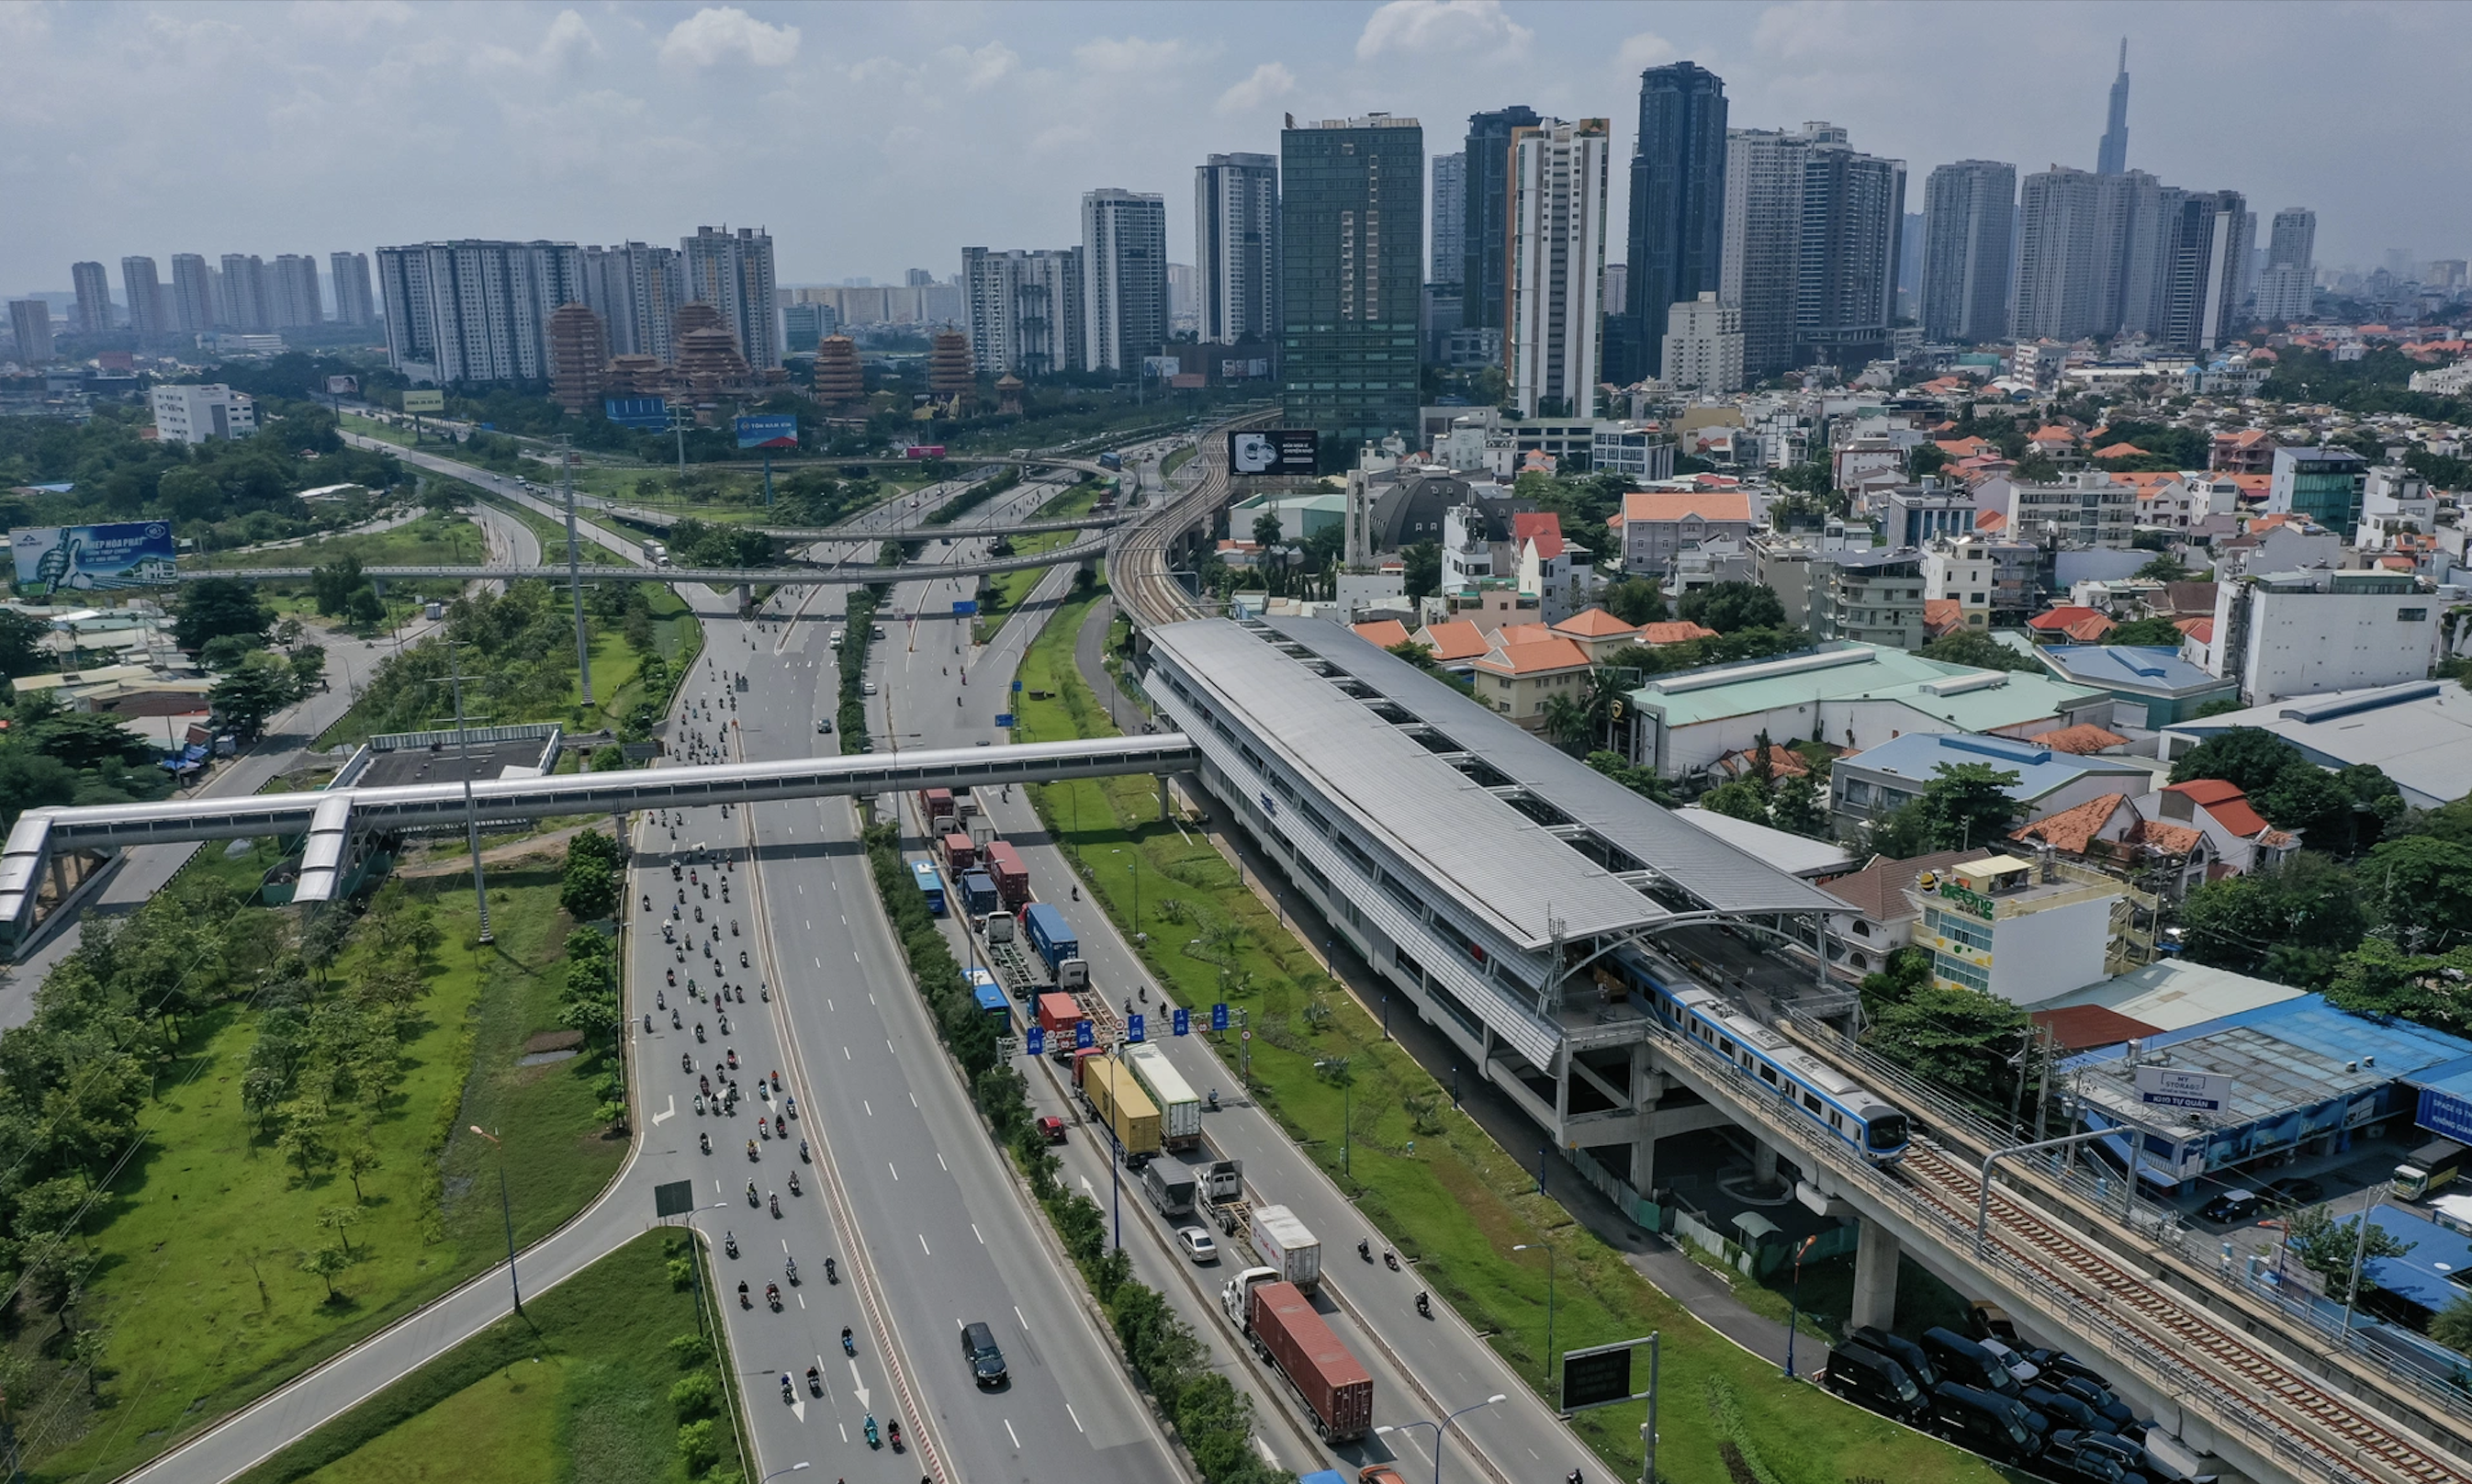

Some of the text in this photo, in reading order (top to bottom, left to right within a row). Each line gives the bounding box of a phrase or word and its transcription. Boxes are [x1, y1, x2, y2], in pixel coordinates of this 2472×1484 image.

[2166, 1082, 2201, 1091] STORAGE
[2433, 1098, 2455, 1112] SPACE
[2433, 1115, 2455, 1129] KHÔNG
